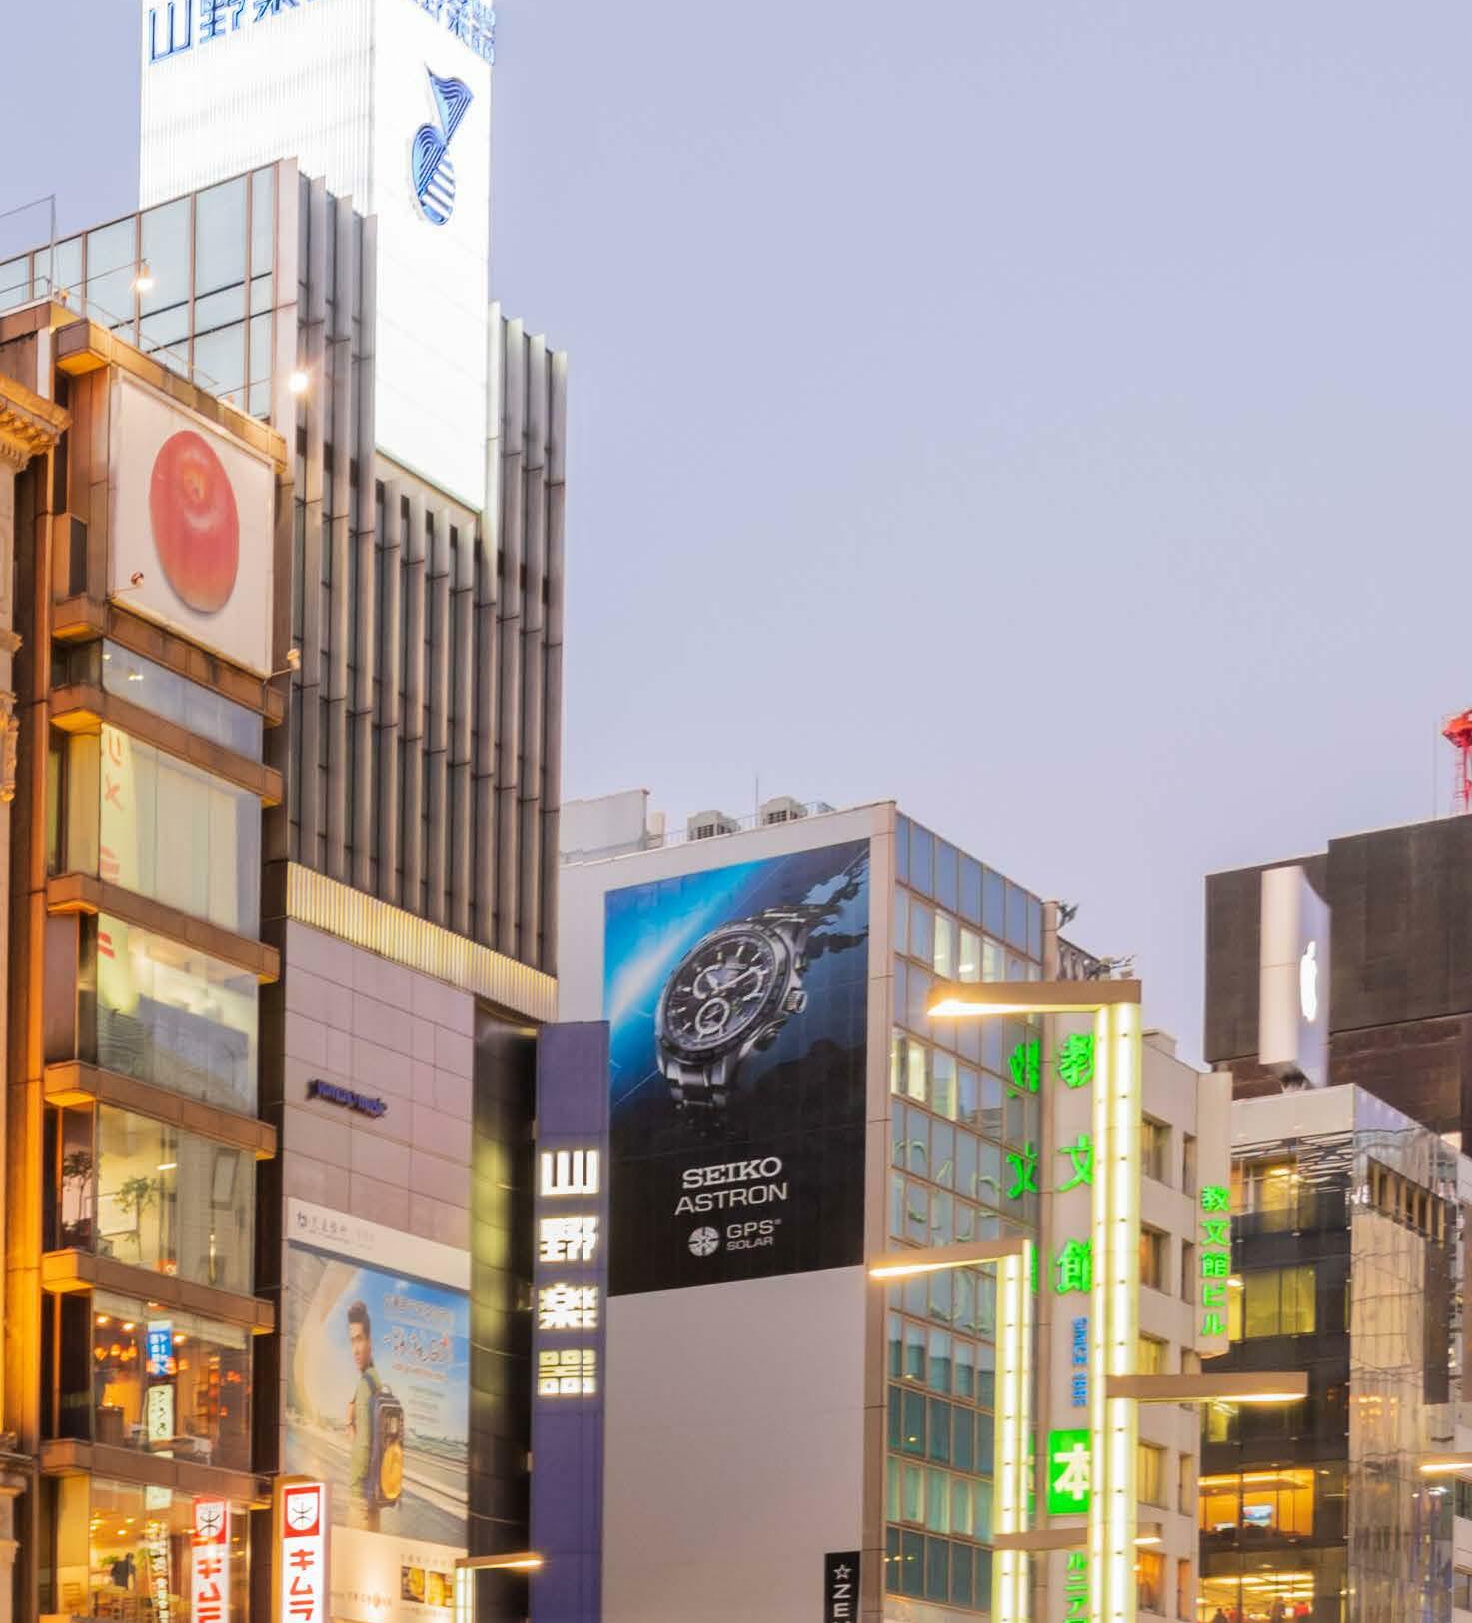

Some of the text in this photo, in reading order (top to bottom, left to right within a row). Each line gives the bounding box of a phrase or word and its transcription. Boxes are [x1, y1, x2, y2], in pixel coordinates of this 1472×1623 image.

[681, 1156, 783, 1189] SEIKO
[673, 1182, 789, 1217] ASTRON
[725, 1235, 774, 1253] SOLAR
[1200, 1185, 1232, 1336] 教文館ビル
[1053, 1442, 1091, 1500] 本
